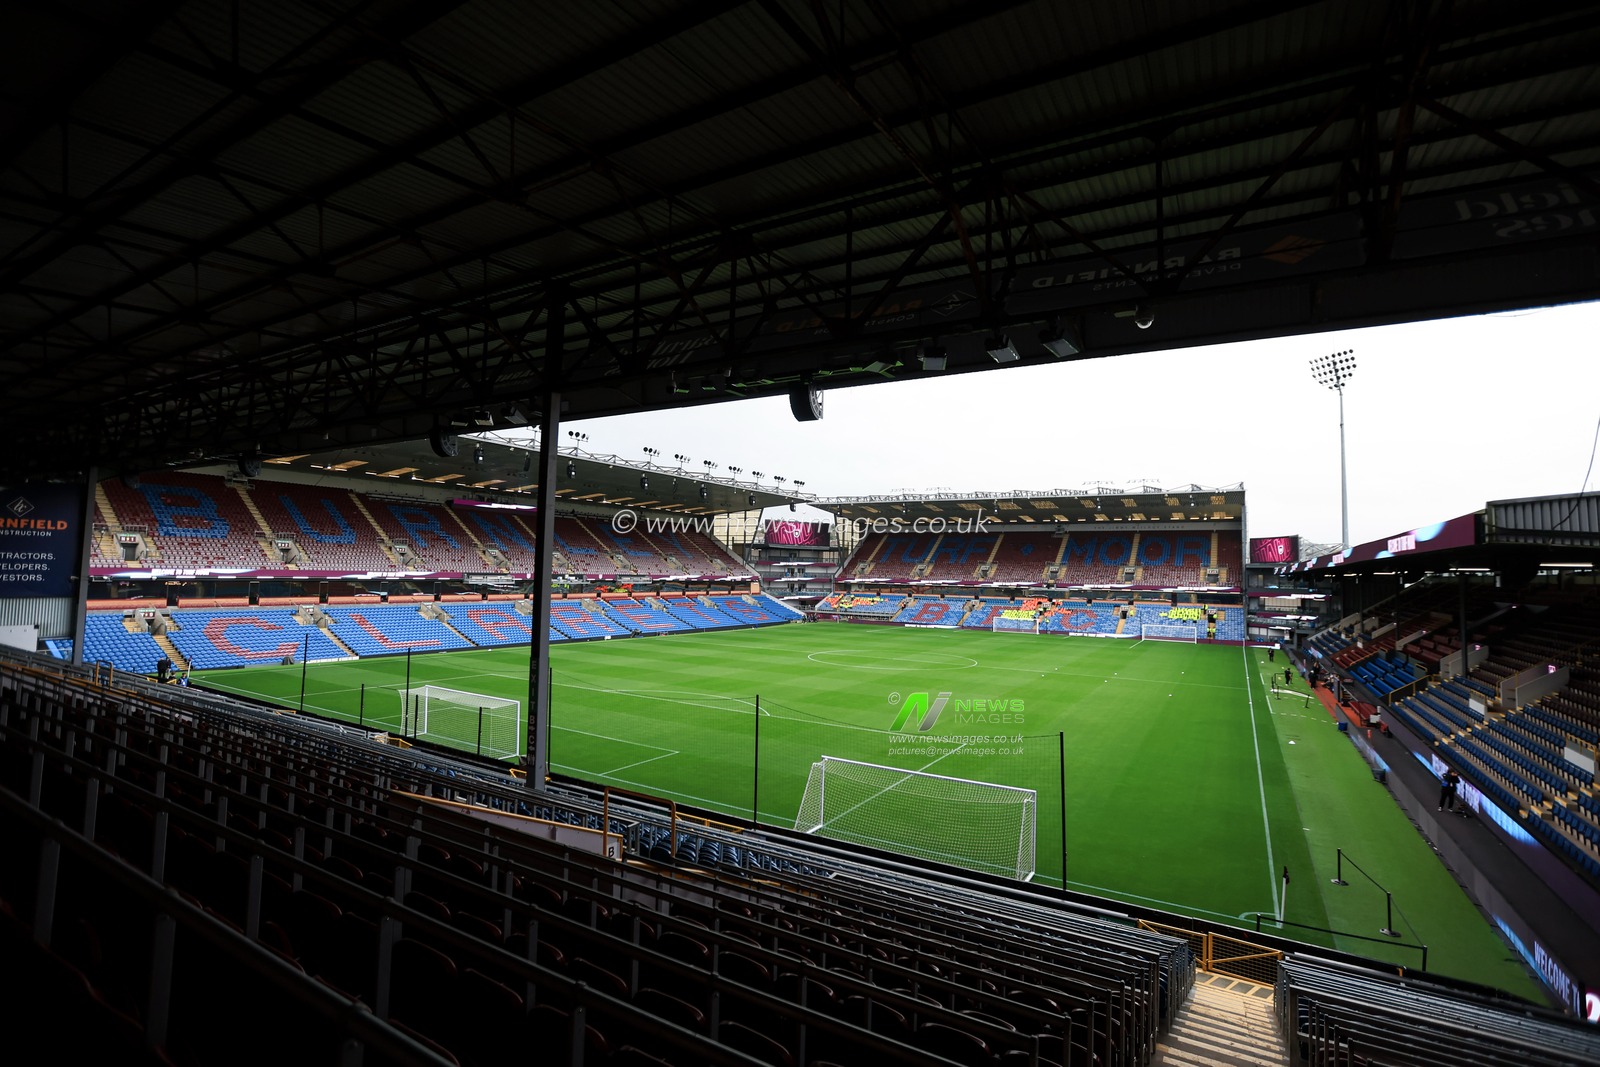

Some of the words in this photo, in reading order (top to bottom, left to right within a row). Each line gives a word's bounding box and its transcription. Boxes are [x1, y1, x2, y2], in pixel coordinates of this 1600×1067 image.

[0, 563, 50, 571] ELOPERS.
[1060, 535, 1212, 567] MOOR
[1534, 940, 1570, 1006] WELCOME
